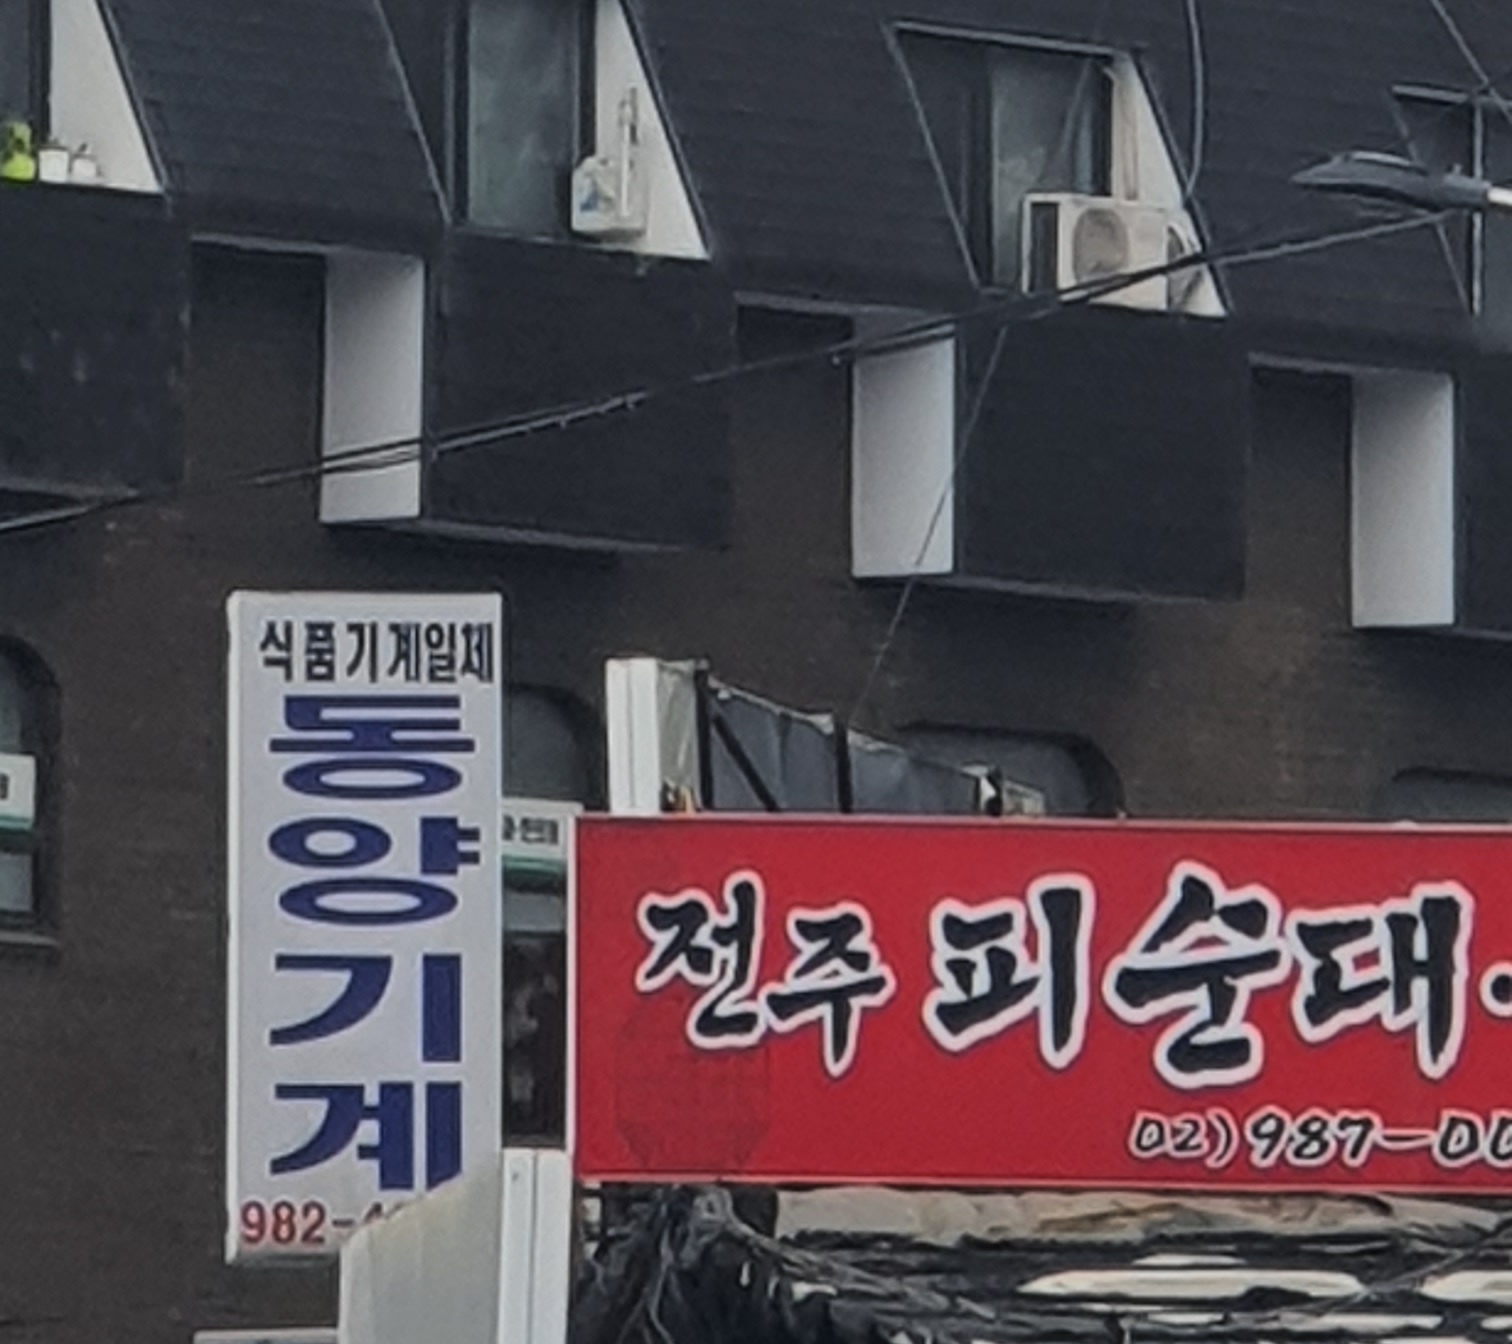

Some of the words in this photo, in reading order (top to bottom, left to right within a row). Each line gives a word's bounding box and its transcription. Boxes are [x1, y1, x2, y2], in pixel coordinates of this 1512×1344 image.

[259, 620, 494, 684] 식품기계일체
[268, 694, 481, 1192] 동양기계
[636, 867, 896, 1077] 전주
